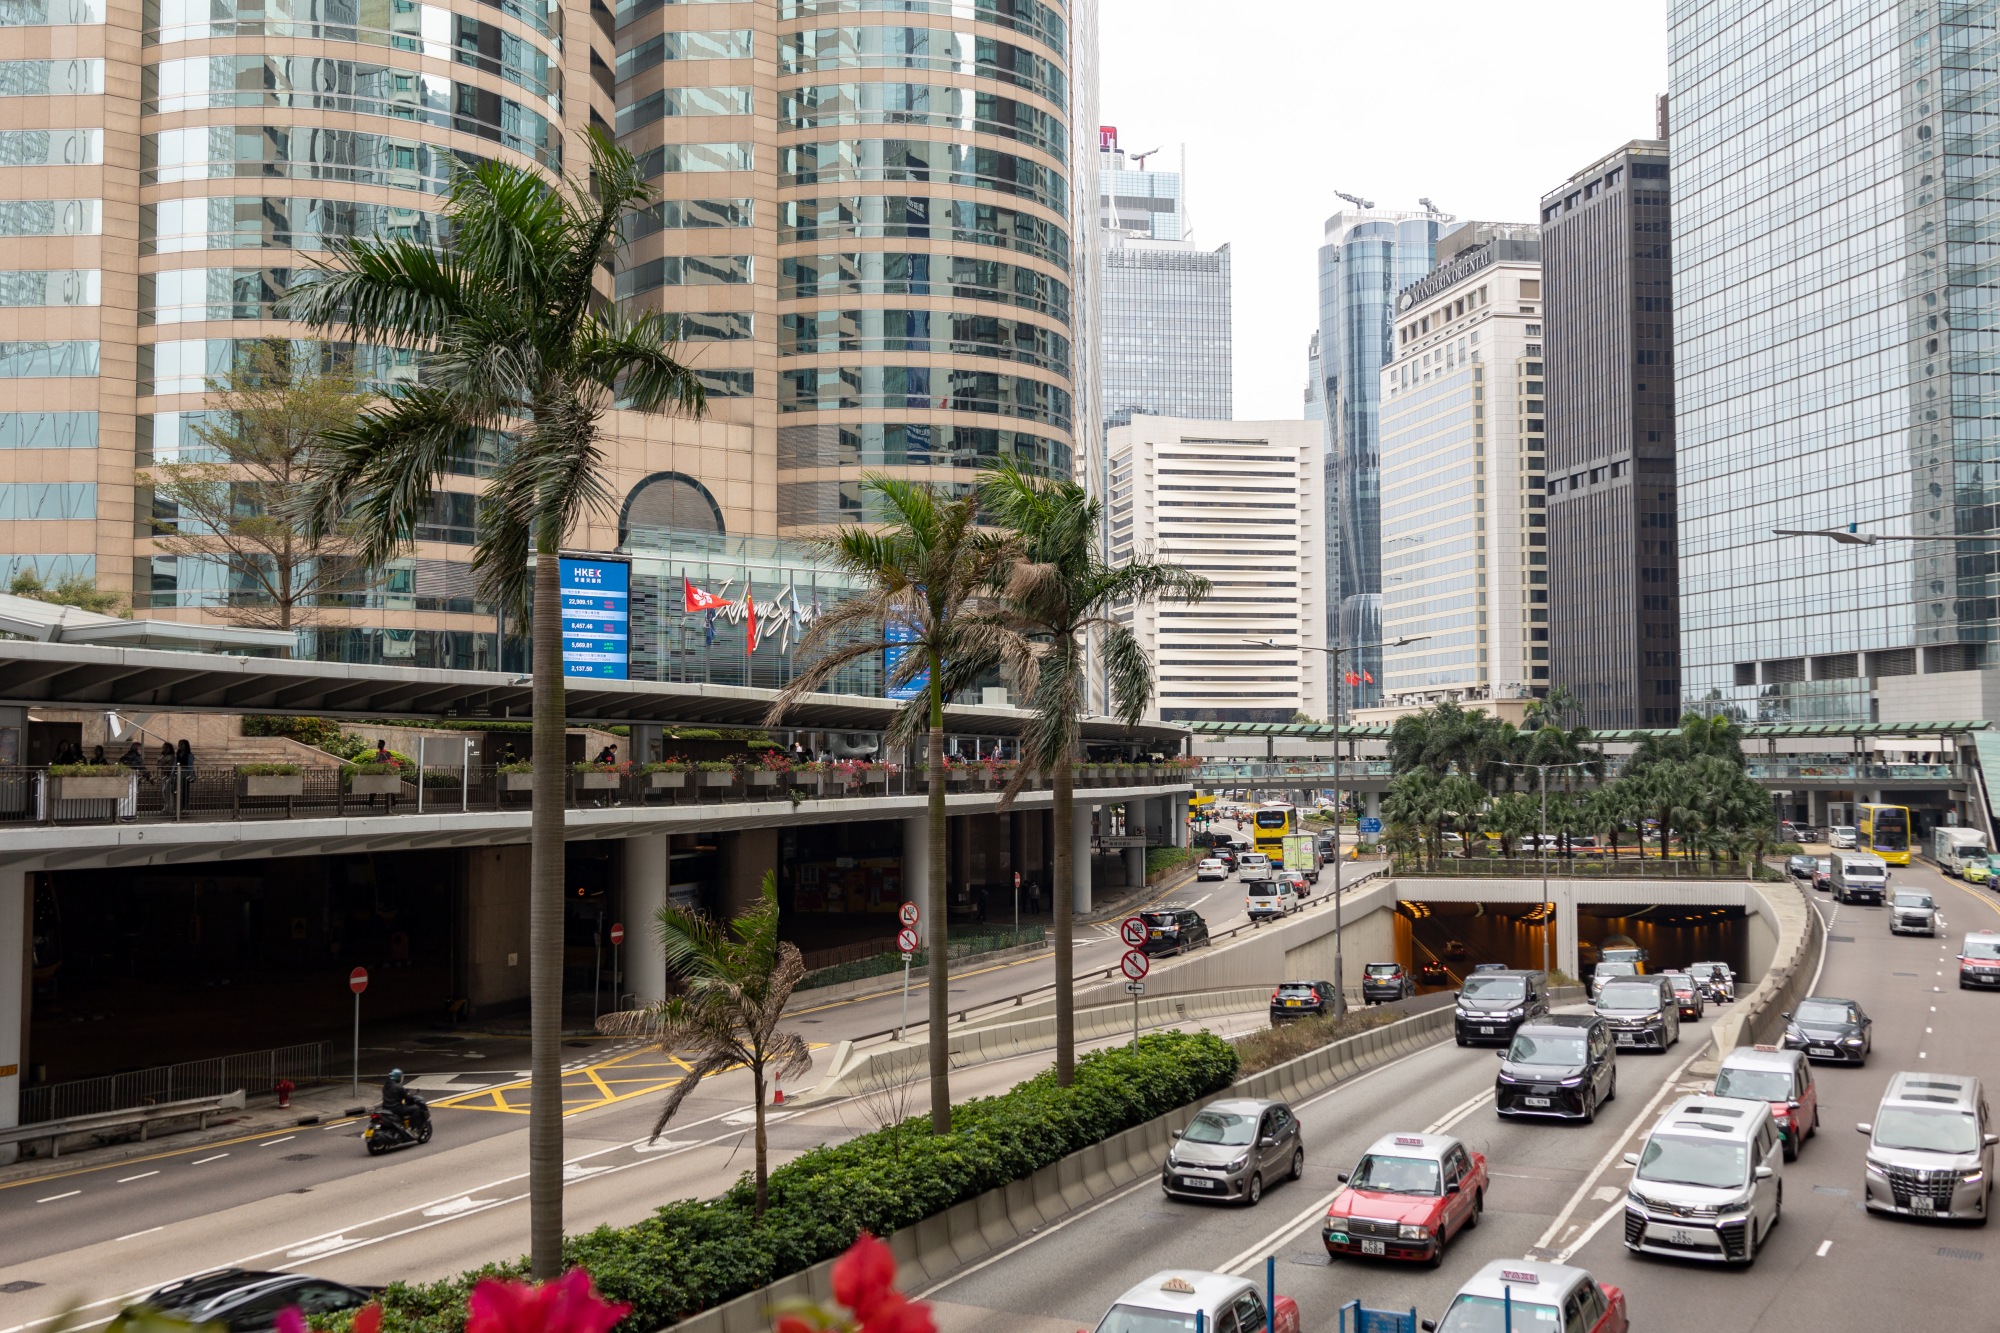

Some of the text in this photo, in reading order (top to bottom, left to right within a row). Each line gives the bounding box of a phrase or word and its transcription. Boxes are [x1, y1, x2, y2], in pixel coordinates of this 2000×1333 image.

[1414, 251, 1490, 304] MANDARIN ORIENTAL
[574, 568, 602, 578] HKEX
[1503, 1271, 1535, 1280] TAXI
